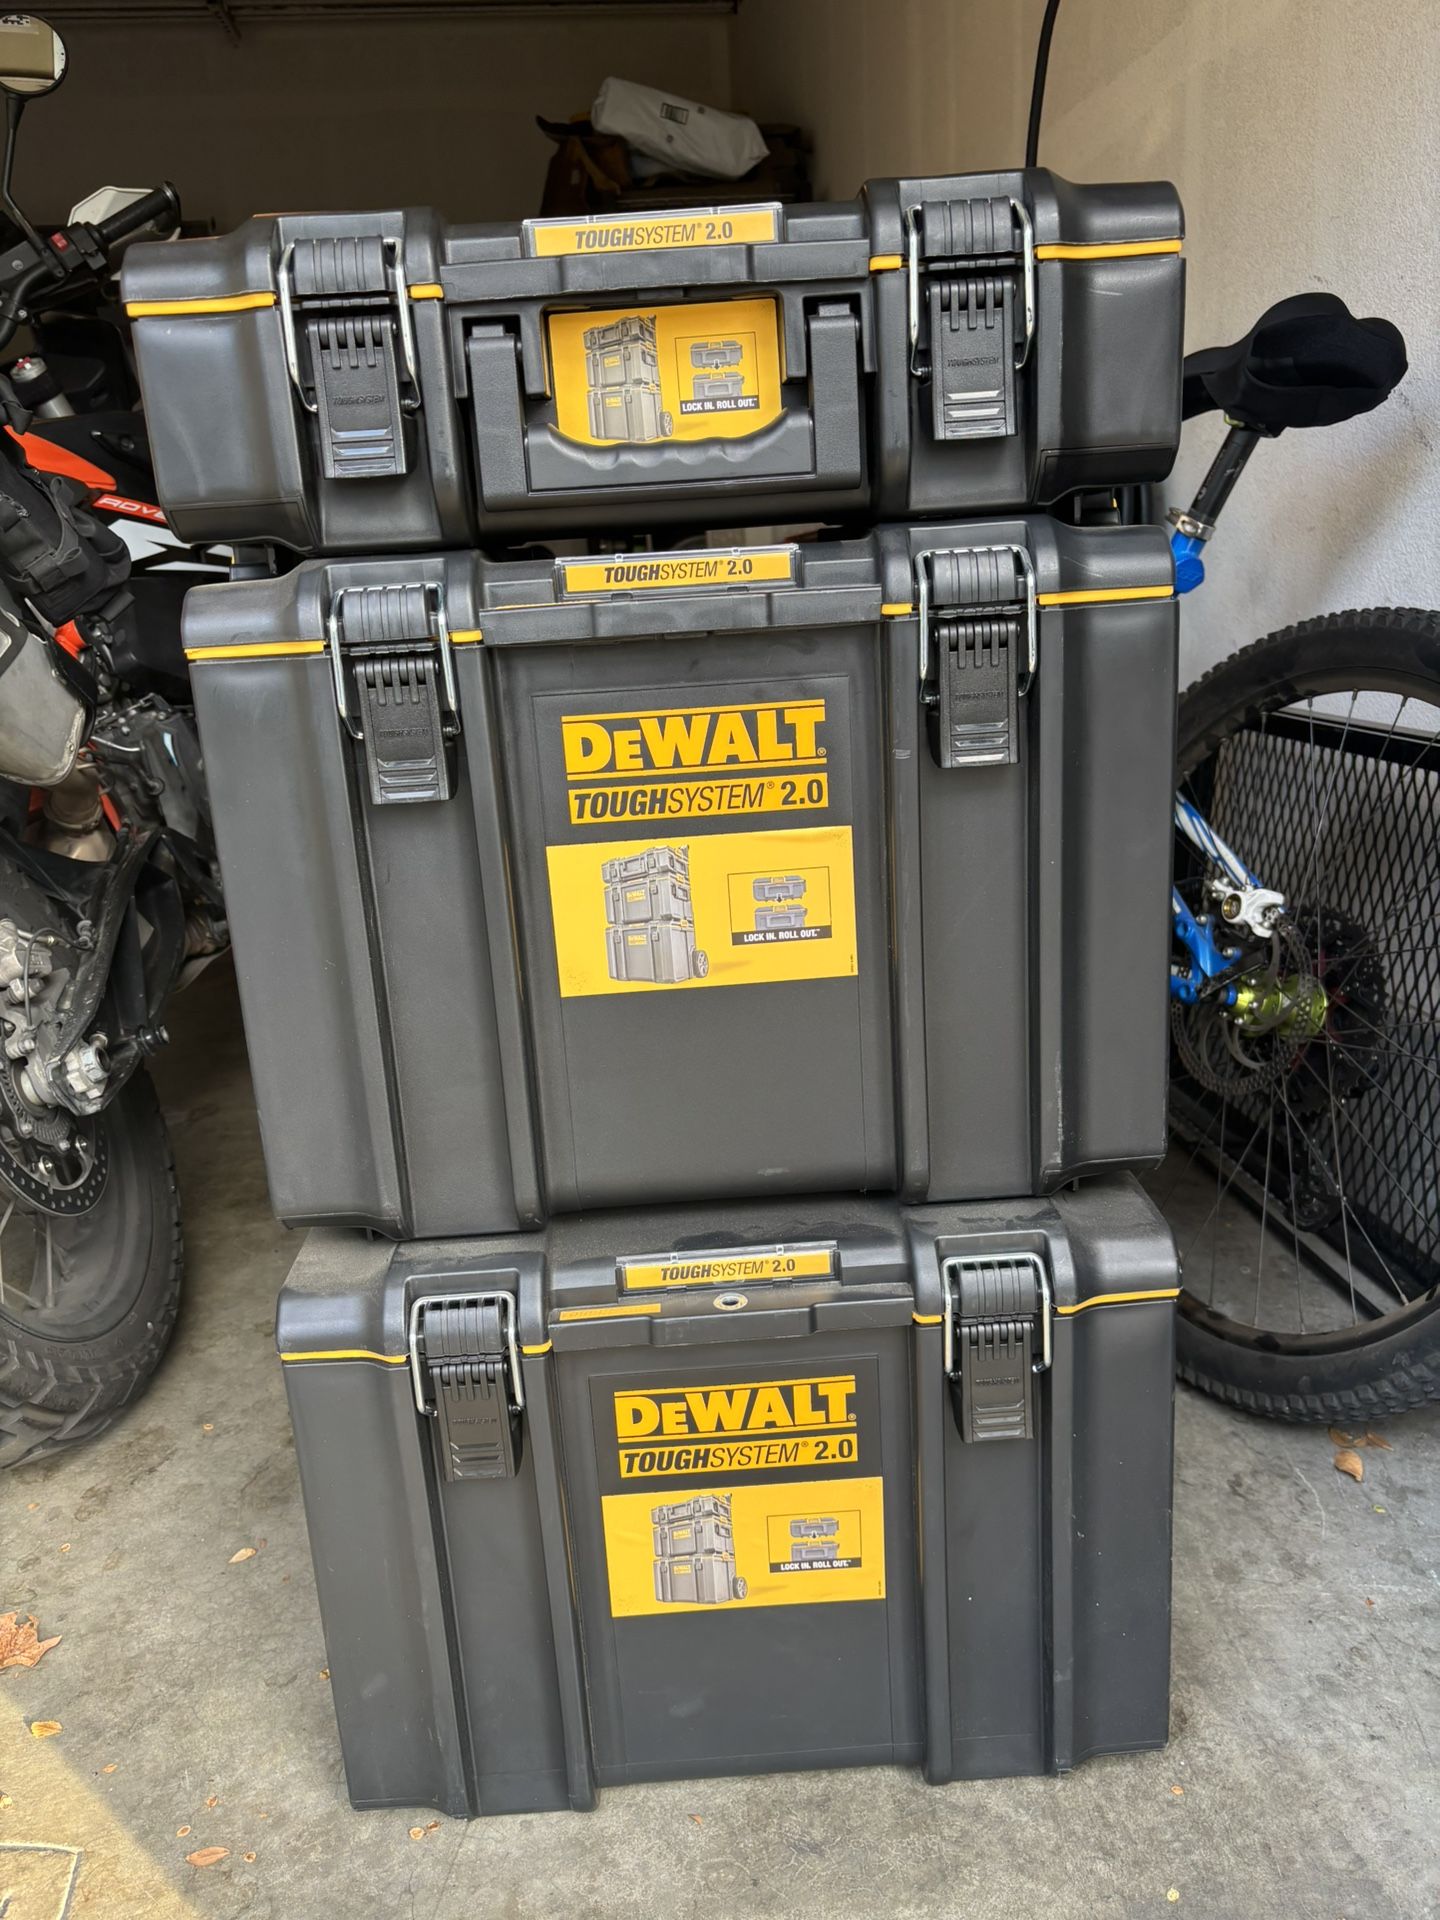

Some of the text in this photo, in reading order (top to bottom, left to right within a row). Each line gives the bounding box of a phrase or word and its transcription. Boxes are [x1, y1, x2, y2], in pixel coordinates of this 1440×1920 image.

[705, 221, 734, 241] 2.0
[682, 402, 703, 412] LOCK
[717, 400, 737, 409] ROLL
[727, 558, 753, 576] 2.0
[780, 778, 824, 806] 2.0
[743, 933, 765, 943] LOCK
[778, 930, 799, 940] ROLL
[772, 1258, 796, 1273] 2.0
[813, 1438, 854, 1462] 2.0
[780, 1562, 800, 1571] LOCK
[812, 1560, 832, 1569] ROLL
